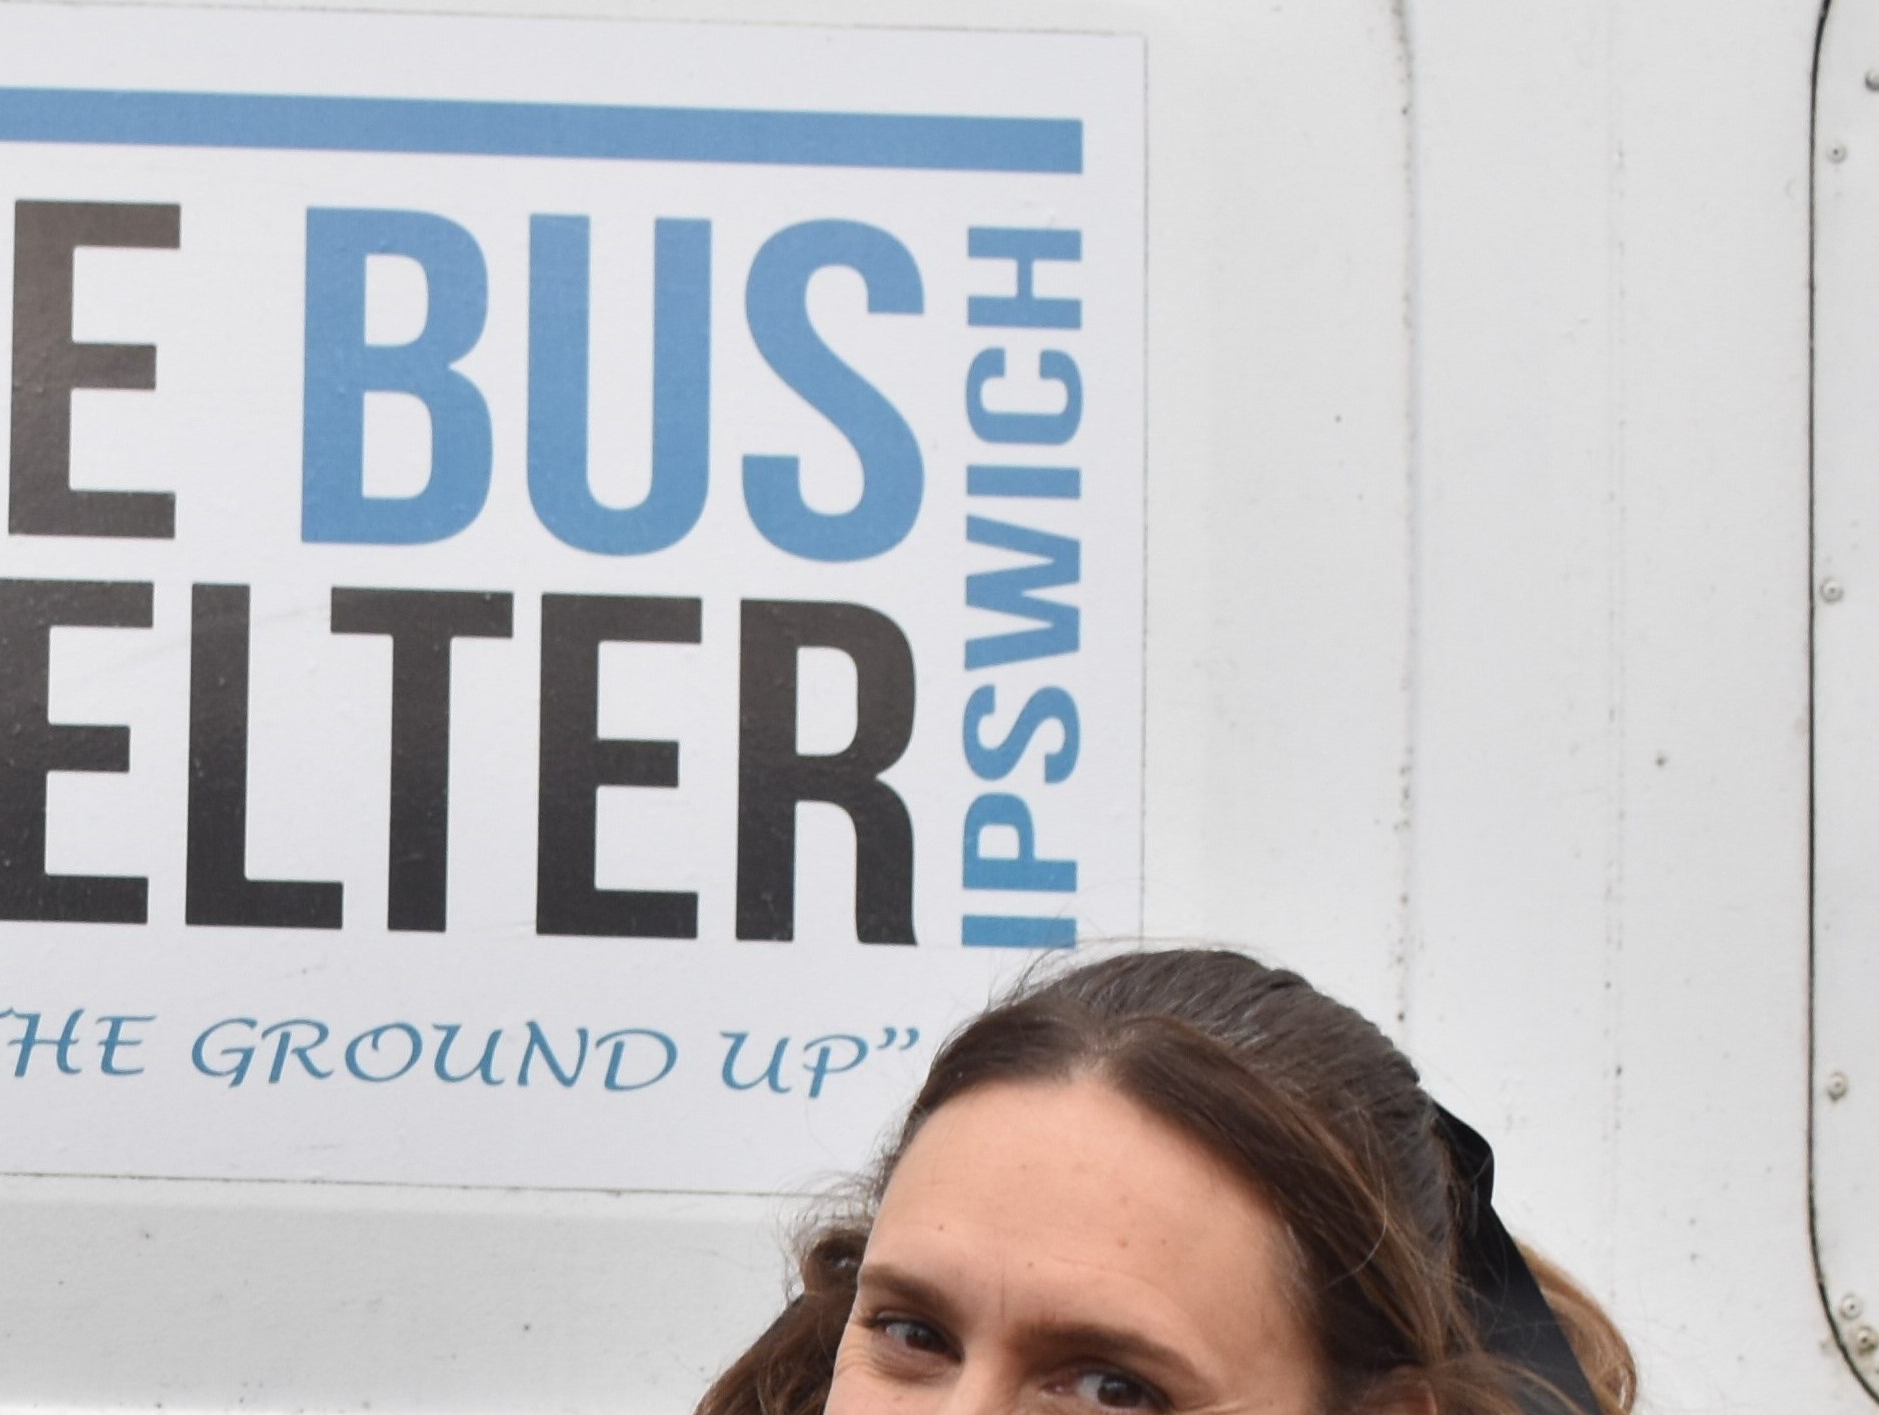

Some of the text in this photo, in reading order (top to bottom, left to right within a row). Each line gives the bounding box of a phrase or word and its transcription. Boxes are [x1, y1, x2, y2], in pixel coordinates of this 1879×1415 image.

[301, 207, 924, 562] BUS
[961, 227, 1083, 951] IPSWICH
[191, 1017, 678, 1092] GROUND
[721, 1026, 920, 1099] UP”
